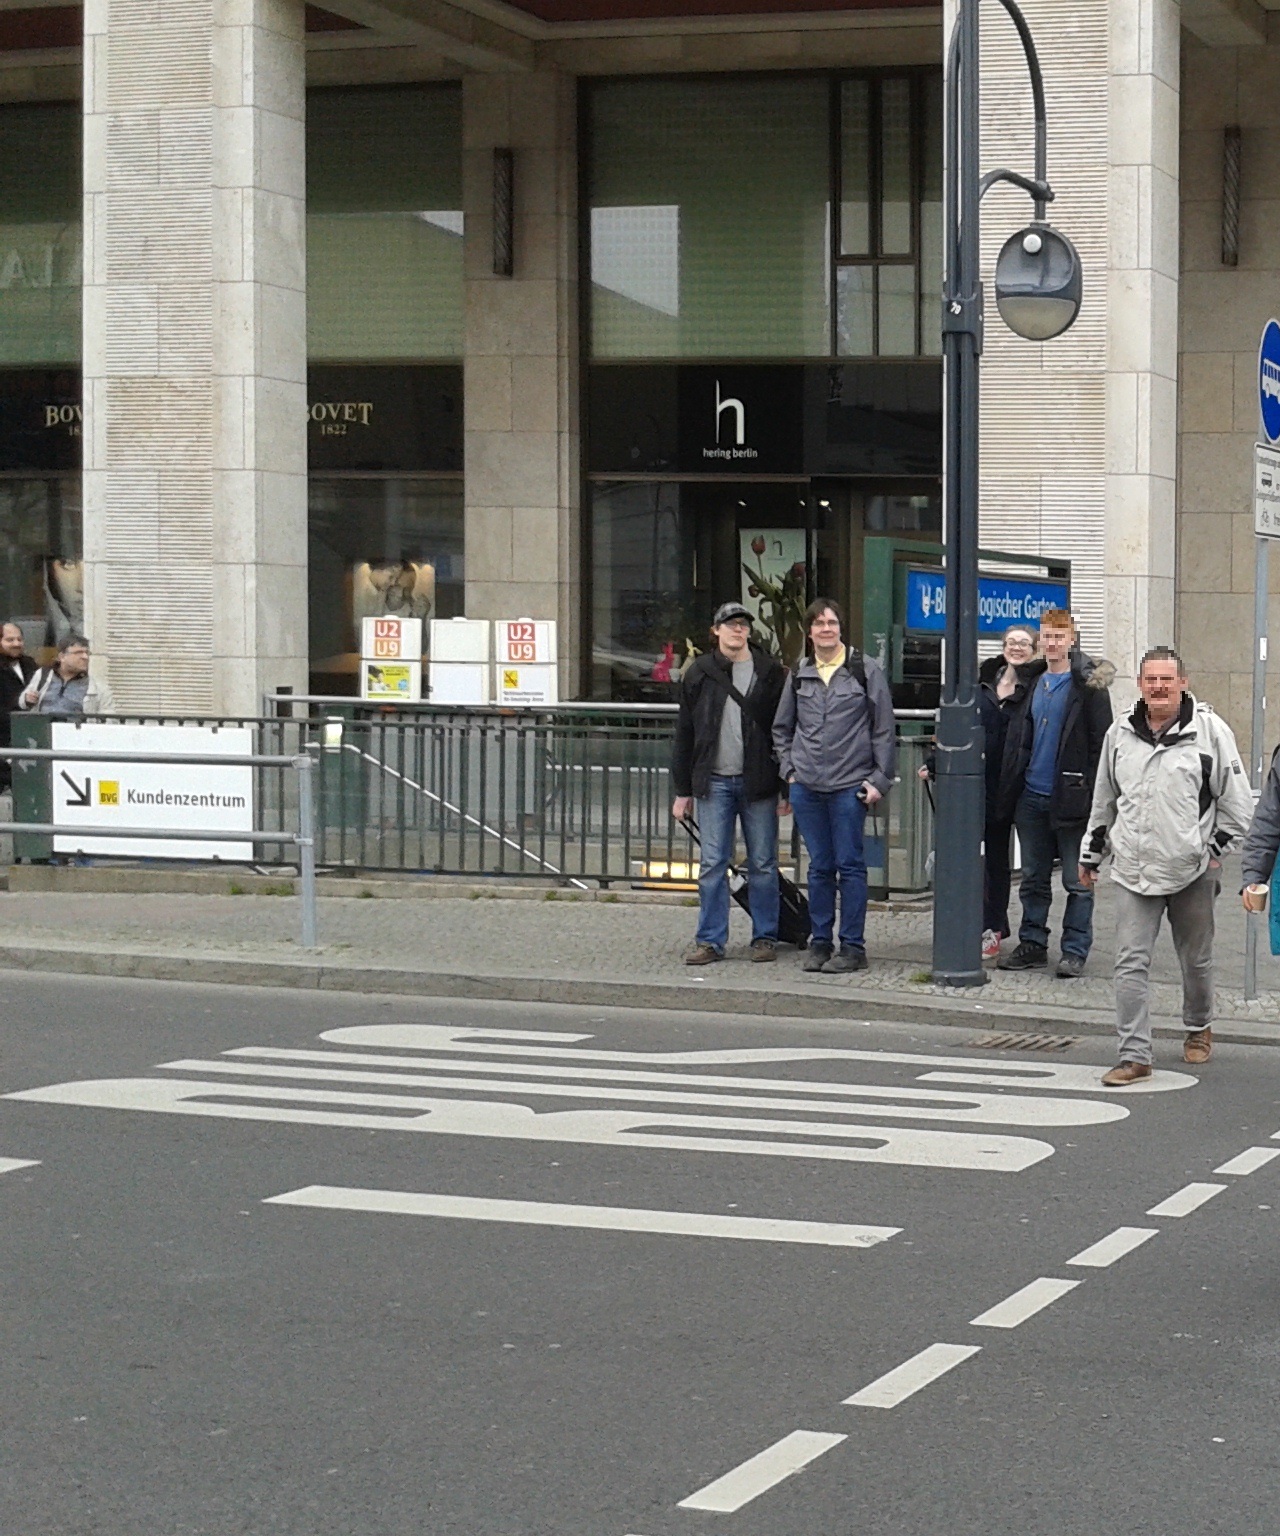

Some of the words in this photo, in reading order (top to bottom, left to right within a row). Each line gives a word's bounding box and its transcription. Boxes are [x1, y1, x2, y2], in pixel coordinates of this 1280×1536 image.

[45, 405, 83, 428] BOV
[305, 403, 374, 425] OVET
[703, 448, 731, 460] hering
[732, 448, 758, 458] berlin
[376, 621, 399, 637] U2
[509, 623, 533, 640] U2
[376, 640, 399, 656] U9
[509, 643, 533, 660] U9
[100, 792, 118, 803] BVG
[127, 788, 246, 808] Kundenzentrum
